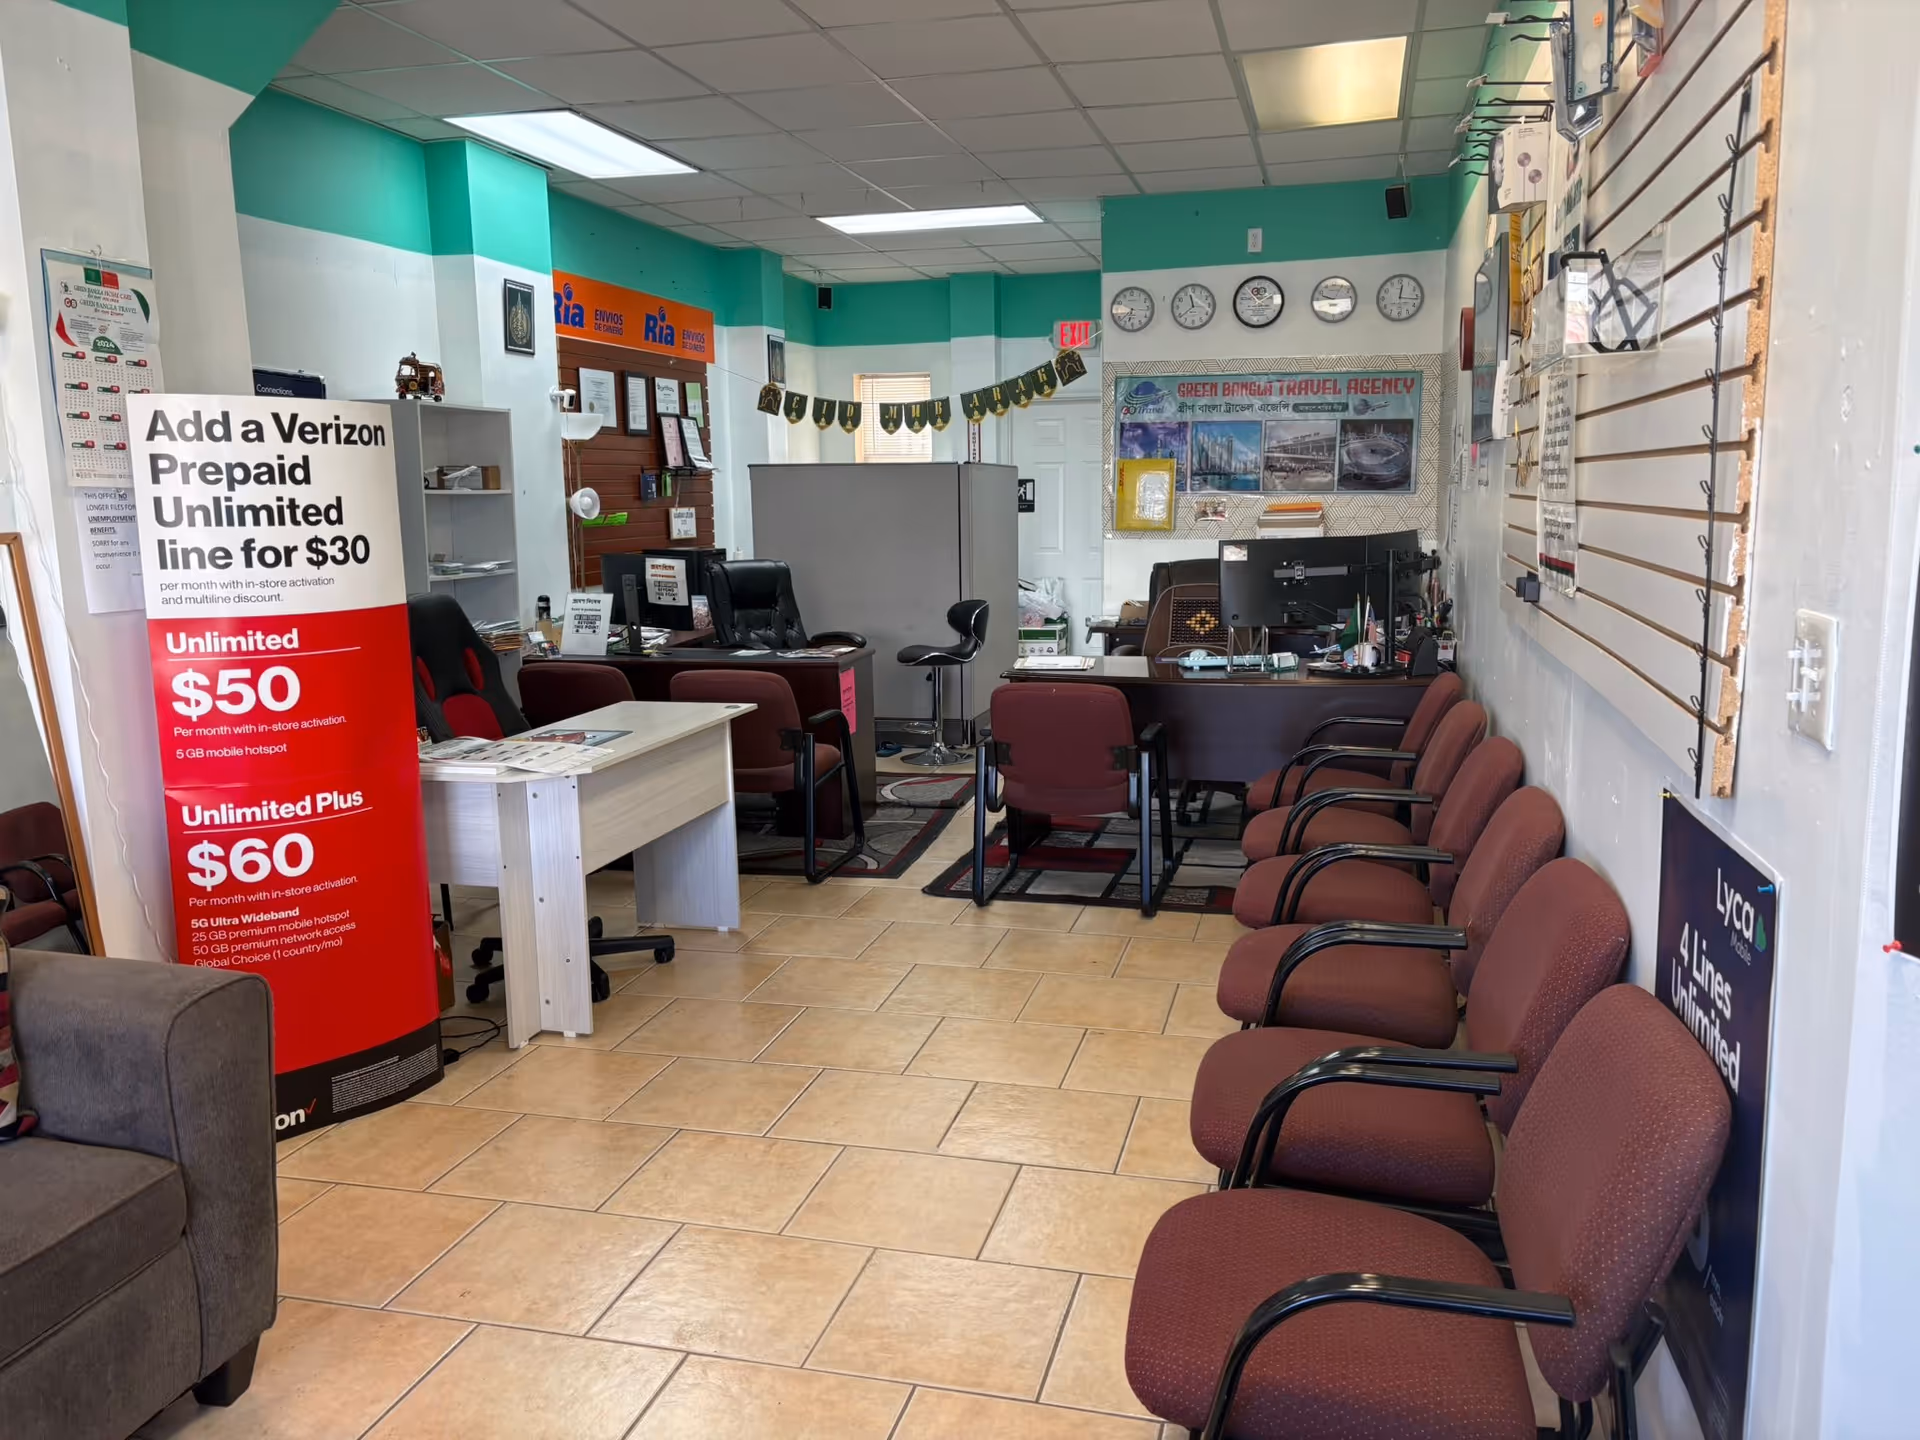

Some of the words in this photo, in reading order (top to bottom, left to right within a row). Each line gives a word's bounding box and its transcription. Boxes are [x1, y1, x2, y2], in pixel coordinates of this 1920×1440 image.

[554, 282, 584, 328] Ria
[595, 310, 623, 325] ENVIOS
[594, 322, 602, 331] DE
[603, 324, 623, 336] DINERO
[644, 306, 675, 346] Ria
[682, 330, 705, 344] ENVIOS
[1060, 321, 1091, 346] EXIT
[96, 340, 115, 348] 2024
[1178, 382, 1218, 398] GREEN
[1222, 381, 1272, 396] BANGLA
[1278, 379, 1342, 396] TRAVEL
[1347, 378, 1415, 395] AGENCY
[146, 410, 232, 442] Add
[241, 419, 264, 443] a
[271, 413, 386, 446] Verizon
[149, 454, 312, 492] Prepaid
[98, 492, 117, 500] OFFICE
[153, 496, 344, 528] Unlimited
[158, 539, 232, 570] line
[240, 538, 298, 568] for
[306, 534, 370, 570] $30
[160, 582, 179, 592] per
[181, 580, 217, 590] month
[220, 579, 242, 589] with
[245, 578, 287, 588] in-store
[289, 576, 334, 587] activation
[162, 594, 183, 605] and
[185, 594, 231, 604] multiline
[233, 593, 283, 603] discount.
[166, 628, 299, 654] Unlimited
[172, 666, 301, 721] $50
[174, 727, 193, 737] Per
[196, 724, 231, 736] month
[233, 723, 256, 734] with
[258, 721, 299, 732] in-store
[176, 749, 185, 759] 5
[186, 748, 204, 759] GB
[206, 745, 243, 758] mobile
[245, 743, 287, 758] hotspot
[182, 796, 311, 827] Unlimited
[316, 790, 363, 816] Plus
[187, 832, 314, 891] $60
[189, 897, 208, 907] Per
[210, 894, 245, 906] month
[247, 892, 270, 903] with
[271, 886, 312, 900] in-store
[1716, 867, 1754, 943] Lyca
[191, 918, 209, 929] 5G
[210, 915, 239, 927] Ultra
[241, 908, 300, 925] Wideband
[192, 931, 207, 942] 25
[208, 929, 227, 941] GB
[229, 924, 276, 941] premium
[278, 918, 312, 933] mobile
[314, 910, 350, 927] hotspot
[193, 945, 208, 956] 50
[210, 943, 228, 954] GB
[230, 938, 278, 955] premium
[280, 930, 321, 946] network
[322, 922, 356, 938] access
[194, 957, 229, 969] Global
[231, 951, 271, 965] Choice
[273, 949, 282, 962] (1
[284, 938, 343, 959] country/mo)
[1730, 930, 1752, 966] Mobile
[1680, 922, 1689, 968] 4
[1692, 929, 1732, 1020] Lines
[1672, 957, 1740, 1094] Unlimited
